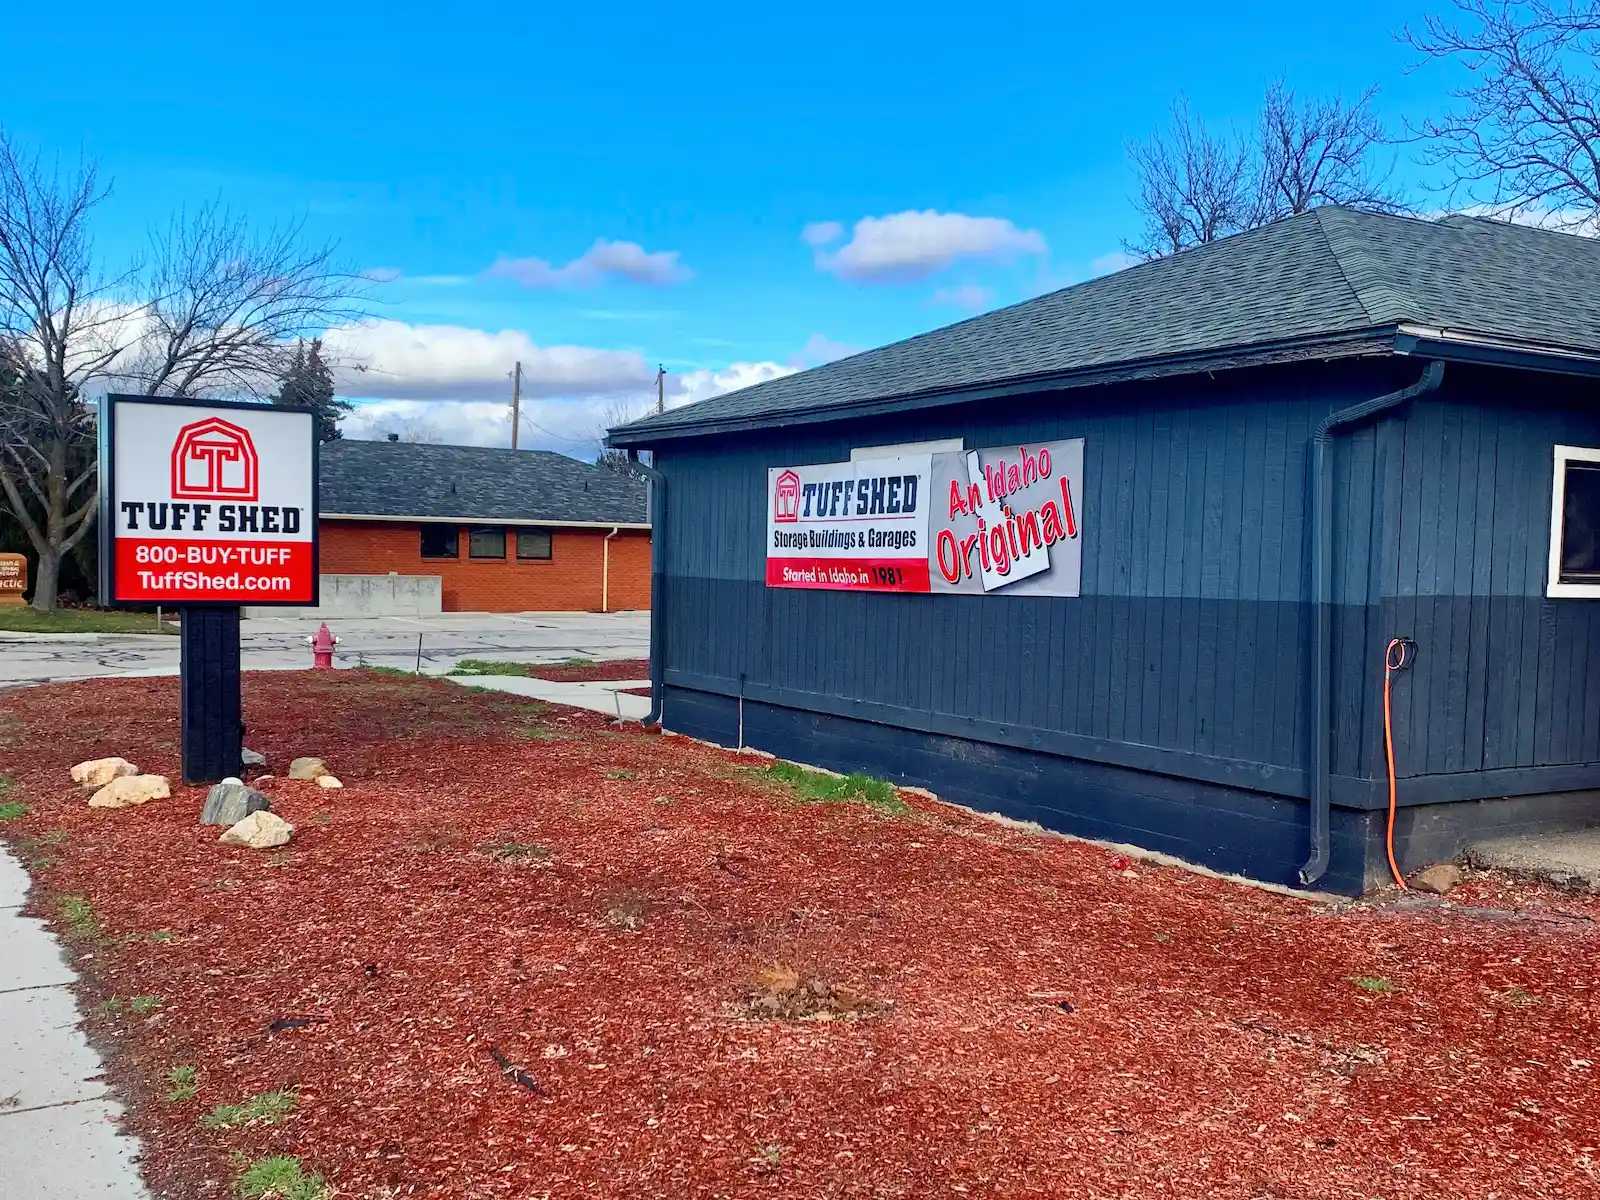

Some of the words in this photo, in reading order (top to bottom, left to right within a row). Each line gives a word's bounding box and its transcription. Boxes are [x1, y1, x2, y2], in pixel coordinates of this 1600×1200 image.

[802, 480, 855, 517] TUFF
[856, 474, 919, 515] SHED
[949, 479, 983, 521] An
[984, 447, 1052, 503] Idaho
[121, 501, 211, 531] TUFF
[218, 504, 301, 534] SHED
[936, 475, 1078, 584] Original
[774, 530, 808, 549] Storage
[809, 529, 856, 550] Buildings
[858, 532, 865, 548] &
[868, 528, 916, 550] Garages
[135, 545, 292, 565] 800-BUY-TUFF
[137, 571, 291, 591] TuffShed.com
[783, 566, 817, 583] Started
[818, 568, 828, 582] in
[829, 567, 857, 584] Idaho
[859, 568, 869, 583] in
[871, 566, 904, 585] 1981
